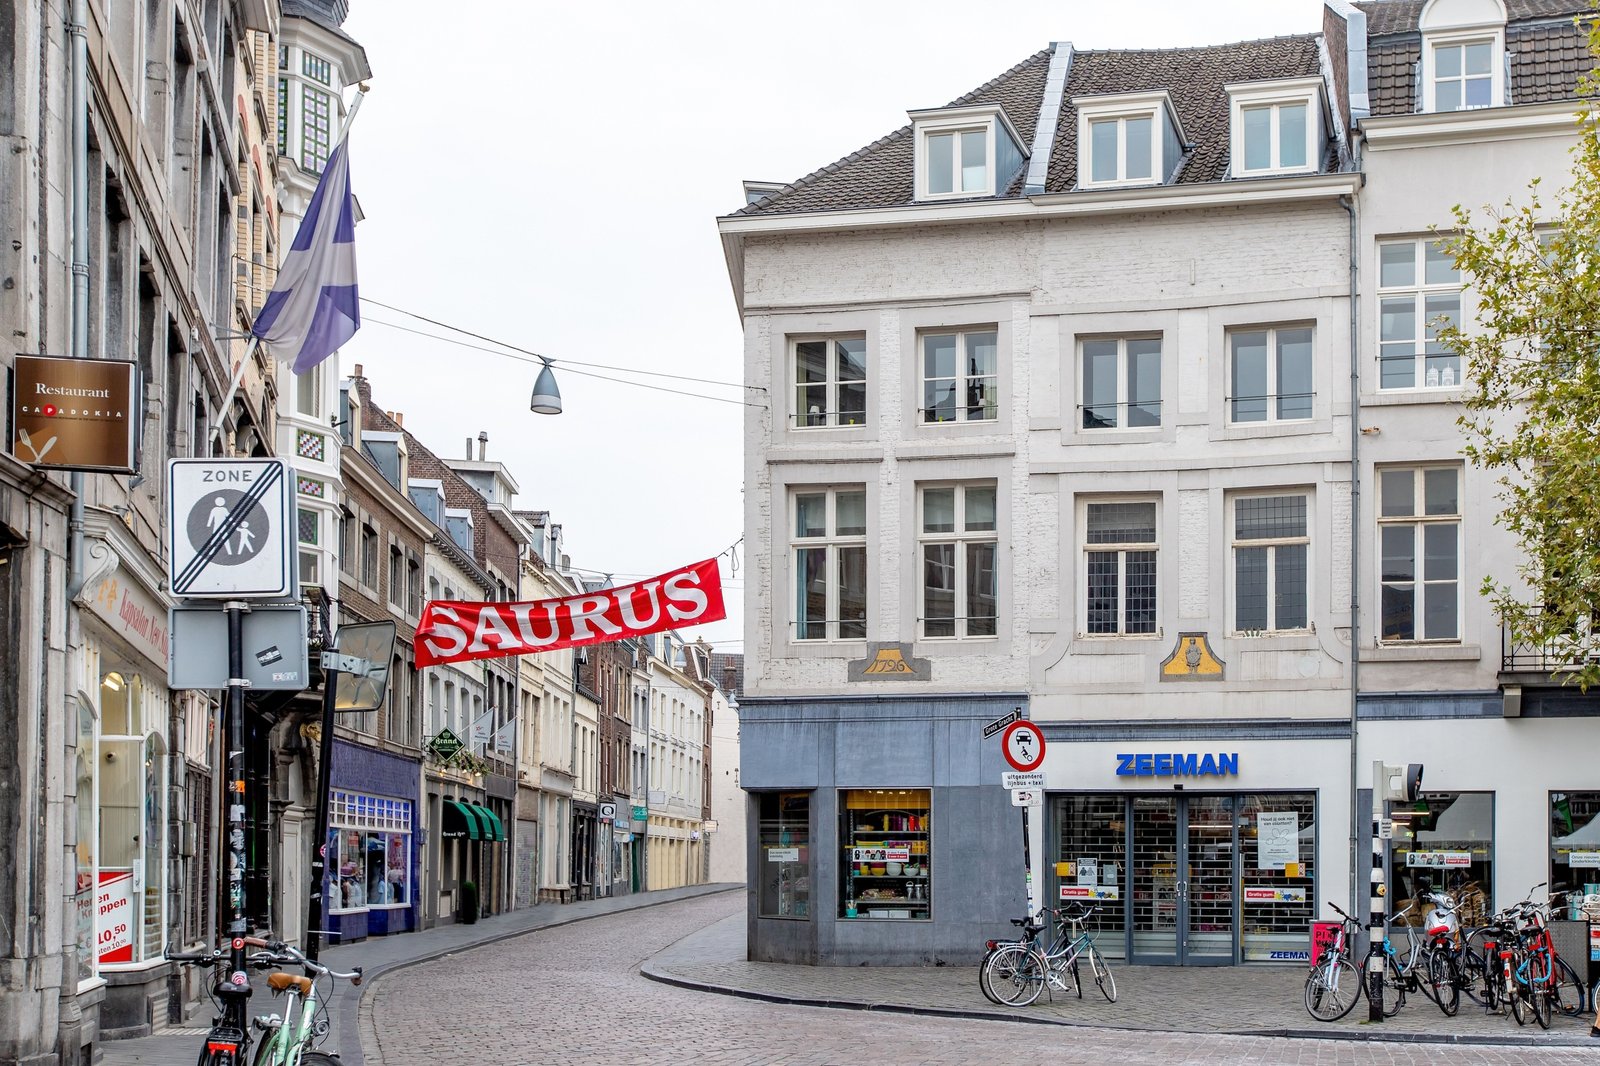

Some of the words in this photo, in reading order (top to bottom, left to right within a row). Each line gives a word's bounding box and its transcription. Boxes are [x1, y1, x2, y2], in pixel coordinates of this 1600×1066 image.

[35, 383, 109, 398] Restaurant
[22, 406, 122, 418] CAPADOKIA
[203, 470, 253, 482] ZONE
[119, 588, 149, 637] Kapsalon
[424, 570, 708, 657] SAURUS
[985, 724, 998, 734] Grote
[997, 715, 1014, 728] Gracht
[435, 736, 458, 746] Brand
[1116, 753, 1238, 775] ZEEMAN
